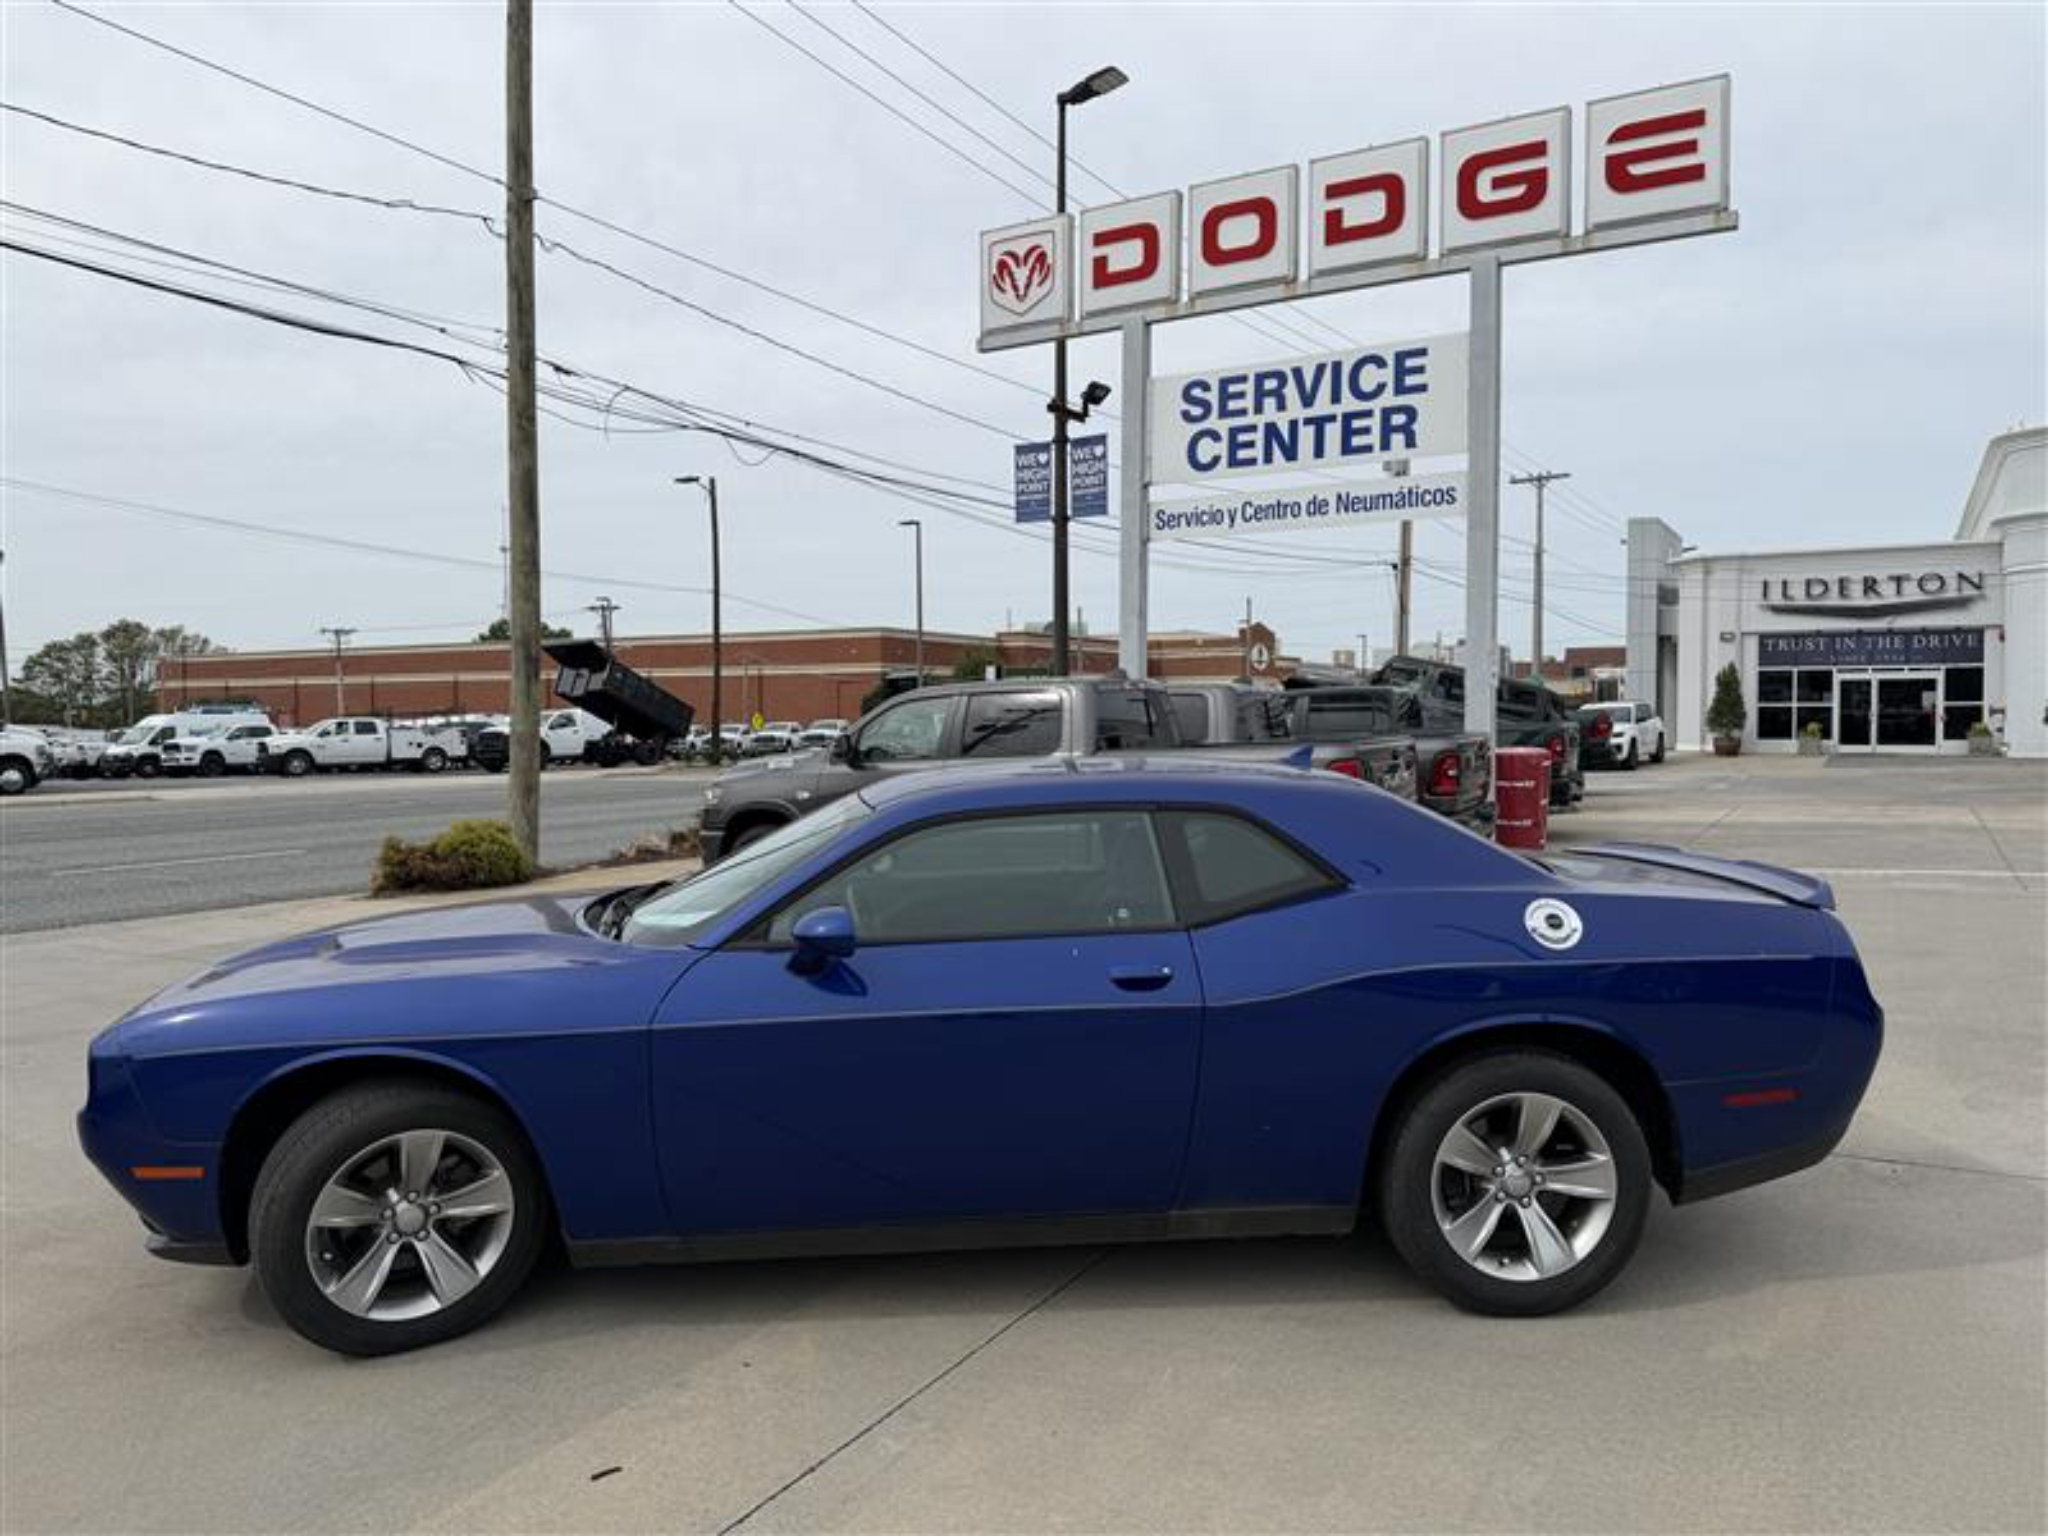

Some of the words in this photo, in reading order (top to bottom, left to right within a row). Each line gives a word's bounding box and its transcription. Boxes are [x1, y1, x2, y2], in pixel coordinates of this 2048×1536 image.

[1093, 109, 1706, 290] DODGE
[1180, 347, 1429, 424] SERVICE
[1187, 404, 1418, 473] CENTER
[1017, 453, 1037, 467] WE
[1072, 447, 1094, 460] WE
[1071, 460, 1105, 475] HIGH
[1017, 480, 1048, 493] POINT
[1072, 474, 1104, 488] POINT
[1155, 504, 1225, 531] Servicio
[1228, 506, 1238, 528] y
[1241, 499, 1301, 523] Centro
[1306, 494, 1329, 517] de
[1336, 484, 1458, 515] Neumáticos
[1762, 572, 1984, 600] ILDERTON
[1764, 636, 1826, 651] TRUST
[1835, 635, 1858, 650] IN
[1864, 634, 1906, 649] THE
[1913, 632, 1979, 649] DRIVE
